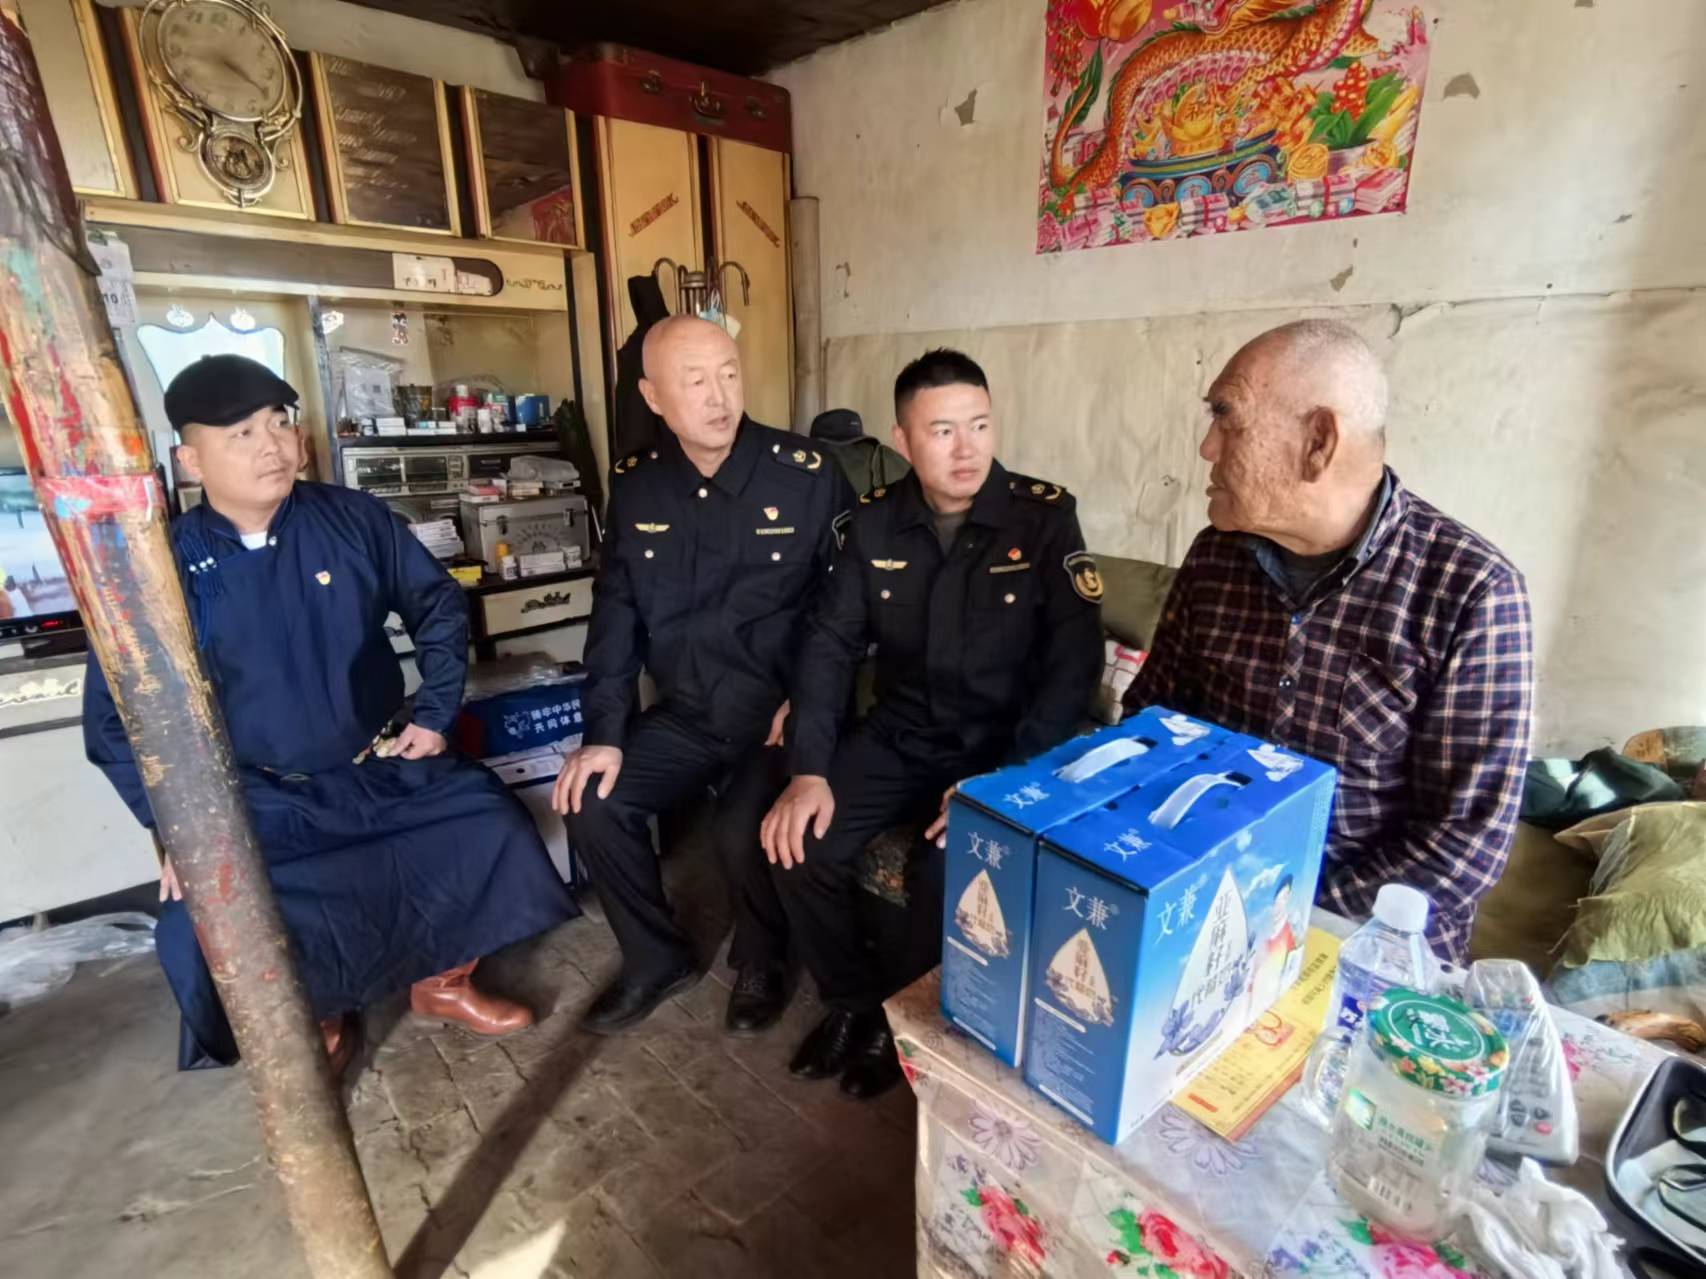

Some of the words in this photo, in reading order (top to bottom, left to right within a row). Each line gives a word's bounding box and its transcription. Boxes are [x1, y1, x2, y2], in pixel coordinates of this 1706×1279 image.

[1003, 783, 1050, 810] 文兼
[967, 831, 1003, 870] 文兼
[1103, 832, 1152, 862] 文兼
[1064, 886, 1107, 930] 文兼
[1153, 886, 1198, 945] 文兼
